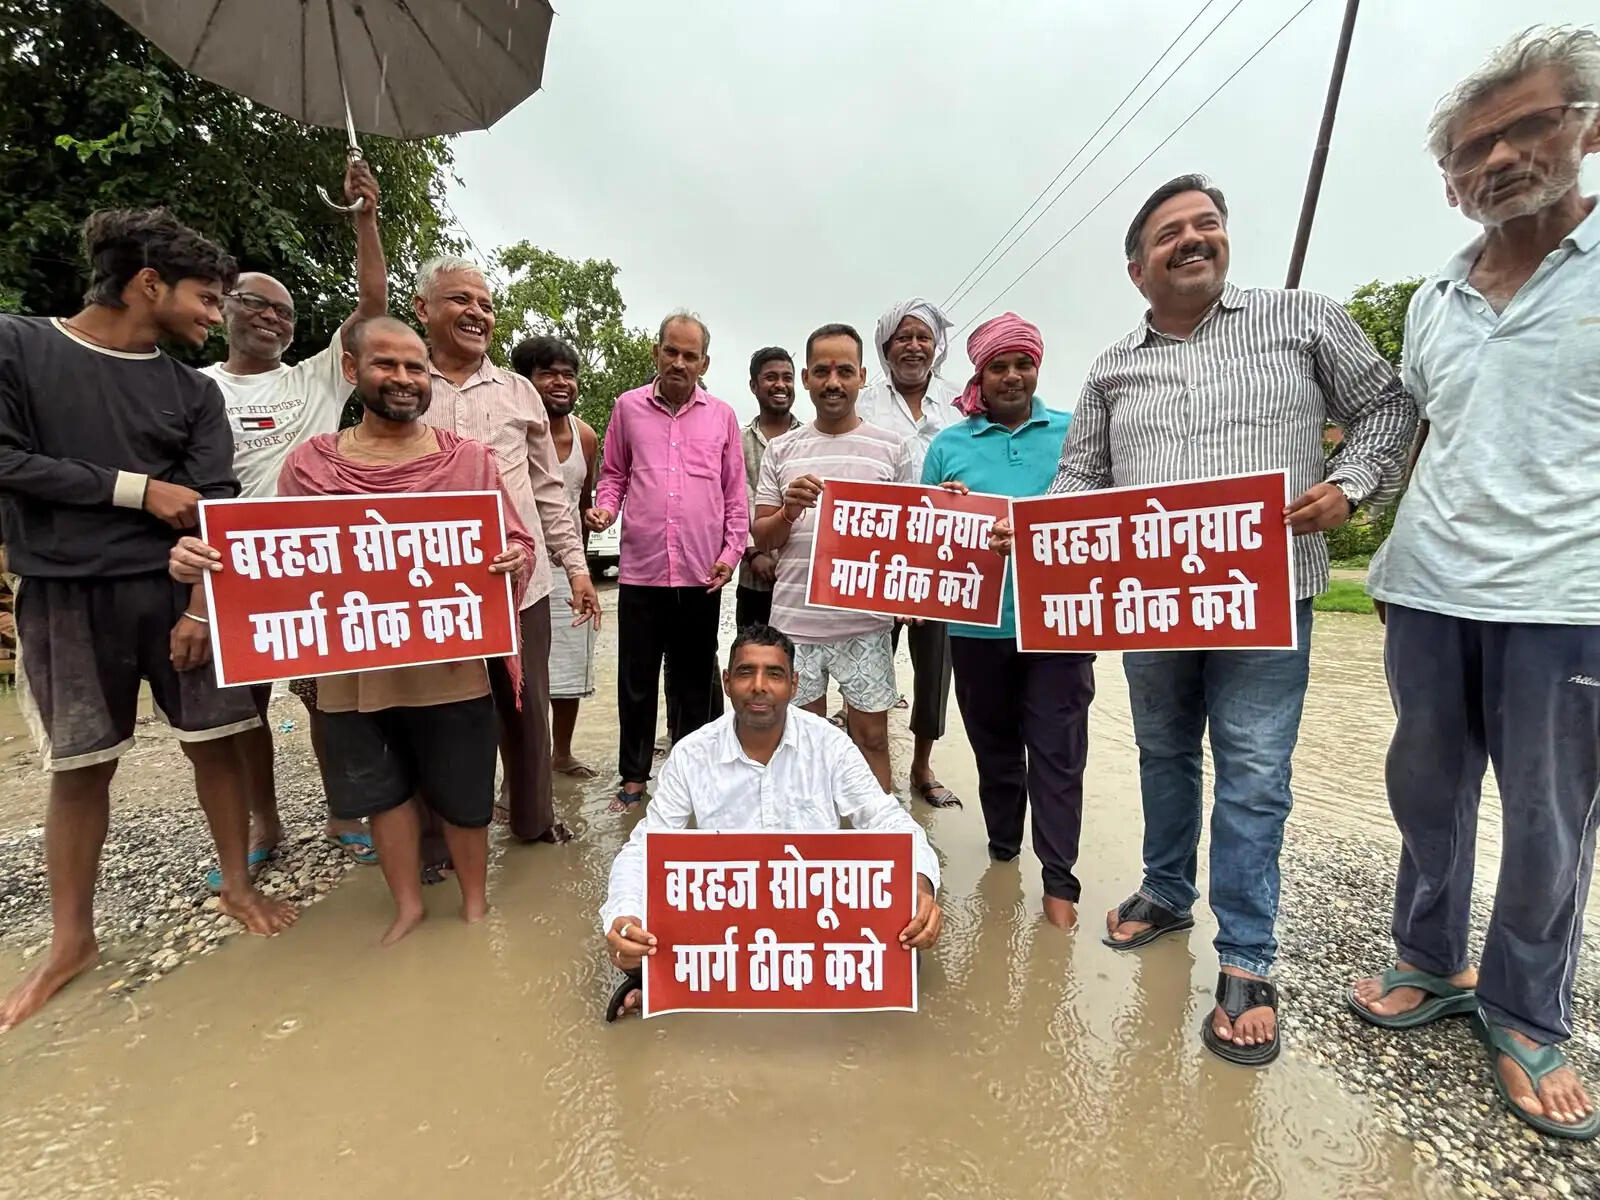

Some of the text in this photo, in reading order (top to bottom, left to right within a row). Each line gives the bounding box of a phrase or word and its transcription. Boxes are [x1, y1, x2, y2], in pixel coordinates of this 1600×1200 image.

[247, 399, 305, 414] HILFIGER
[244, 436, 284, 449] YORK
[226, 508, 484, 588] बरहज सोनूघाट
[832, 495, 997, 562] बरहज सोनूघाट
[1029, 497, 1265, 575] बरहज सोनूघाट
[830, 550, 985, 610] मार्ग ठीक करो
[1041, 568, 1259, 636] मार्ग ठीक करो
[249, 582, 483, 661] मार्ग ठीक करो
[663, 844, 895, 930] बरहज सोनूघाट
[672, 926, 887, 992] मार्ग ठीक करो
